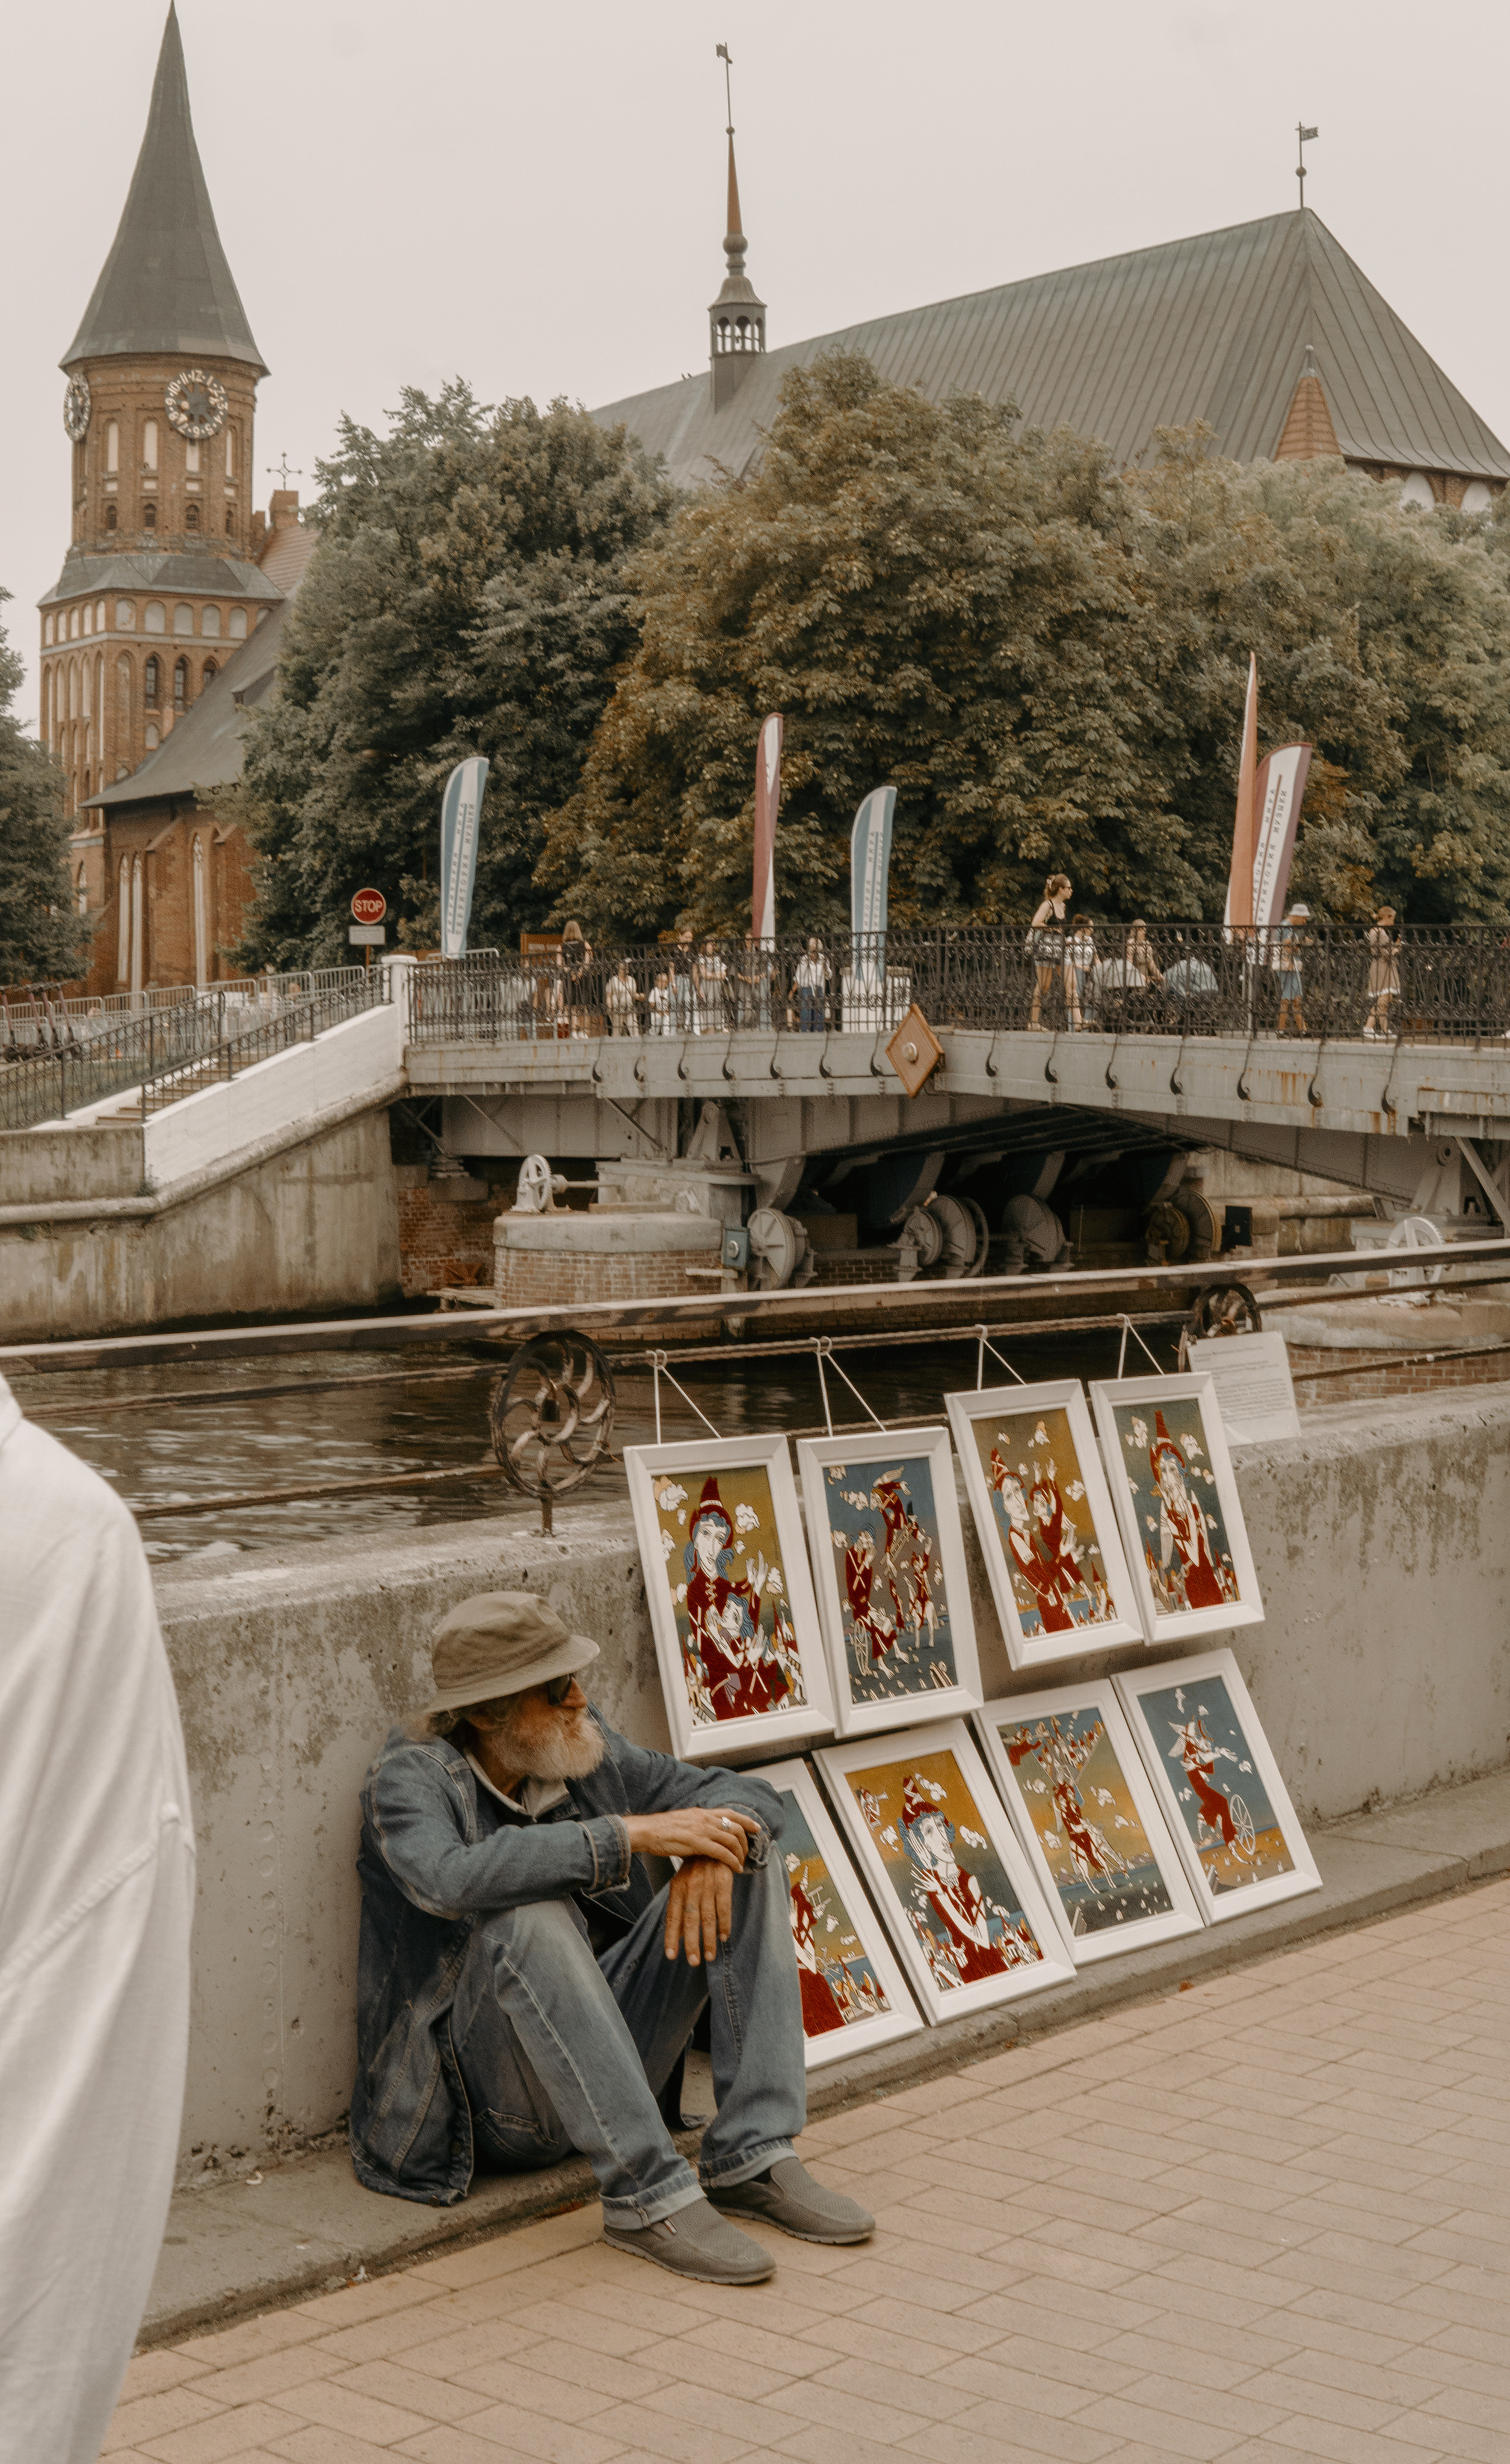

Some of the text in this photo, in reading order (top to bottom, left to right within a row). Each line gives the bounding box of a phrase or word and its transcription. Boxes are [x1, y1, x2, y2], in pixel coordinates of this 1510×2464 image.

[191, 369, 203, 383] 12
[167, 381, 181, 395] 10
[354, 899, 383, 913] STOP
